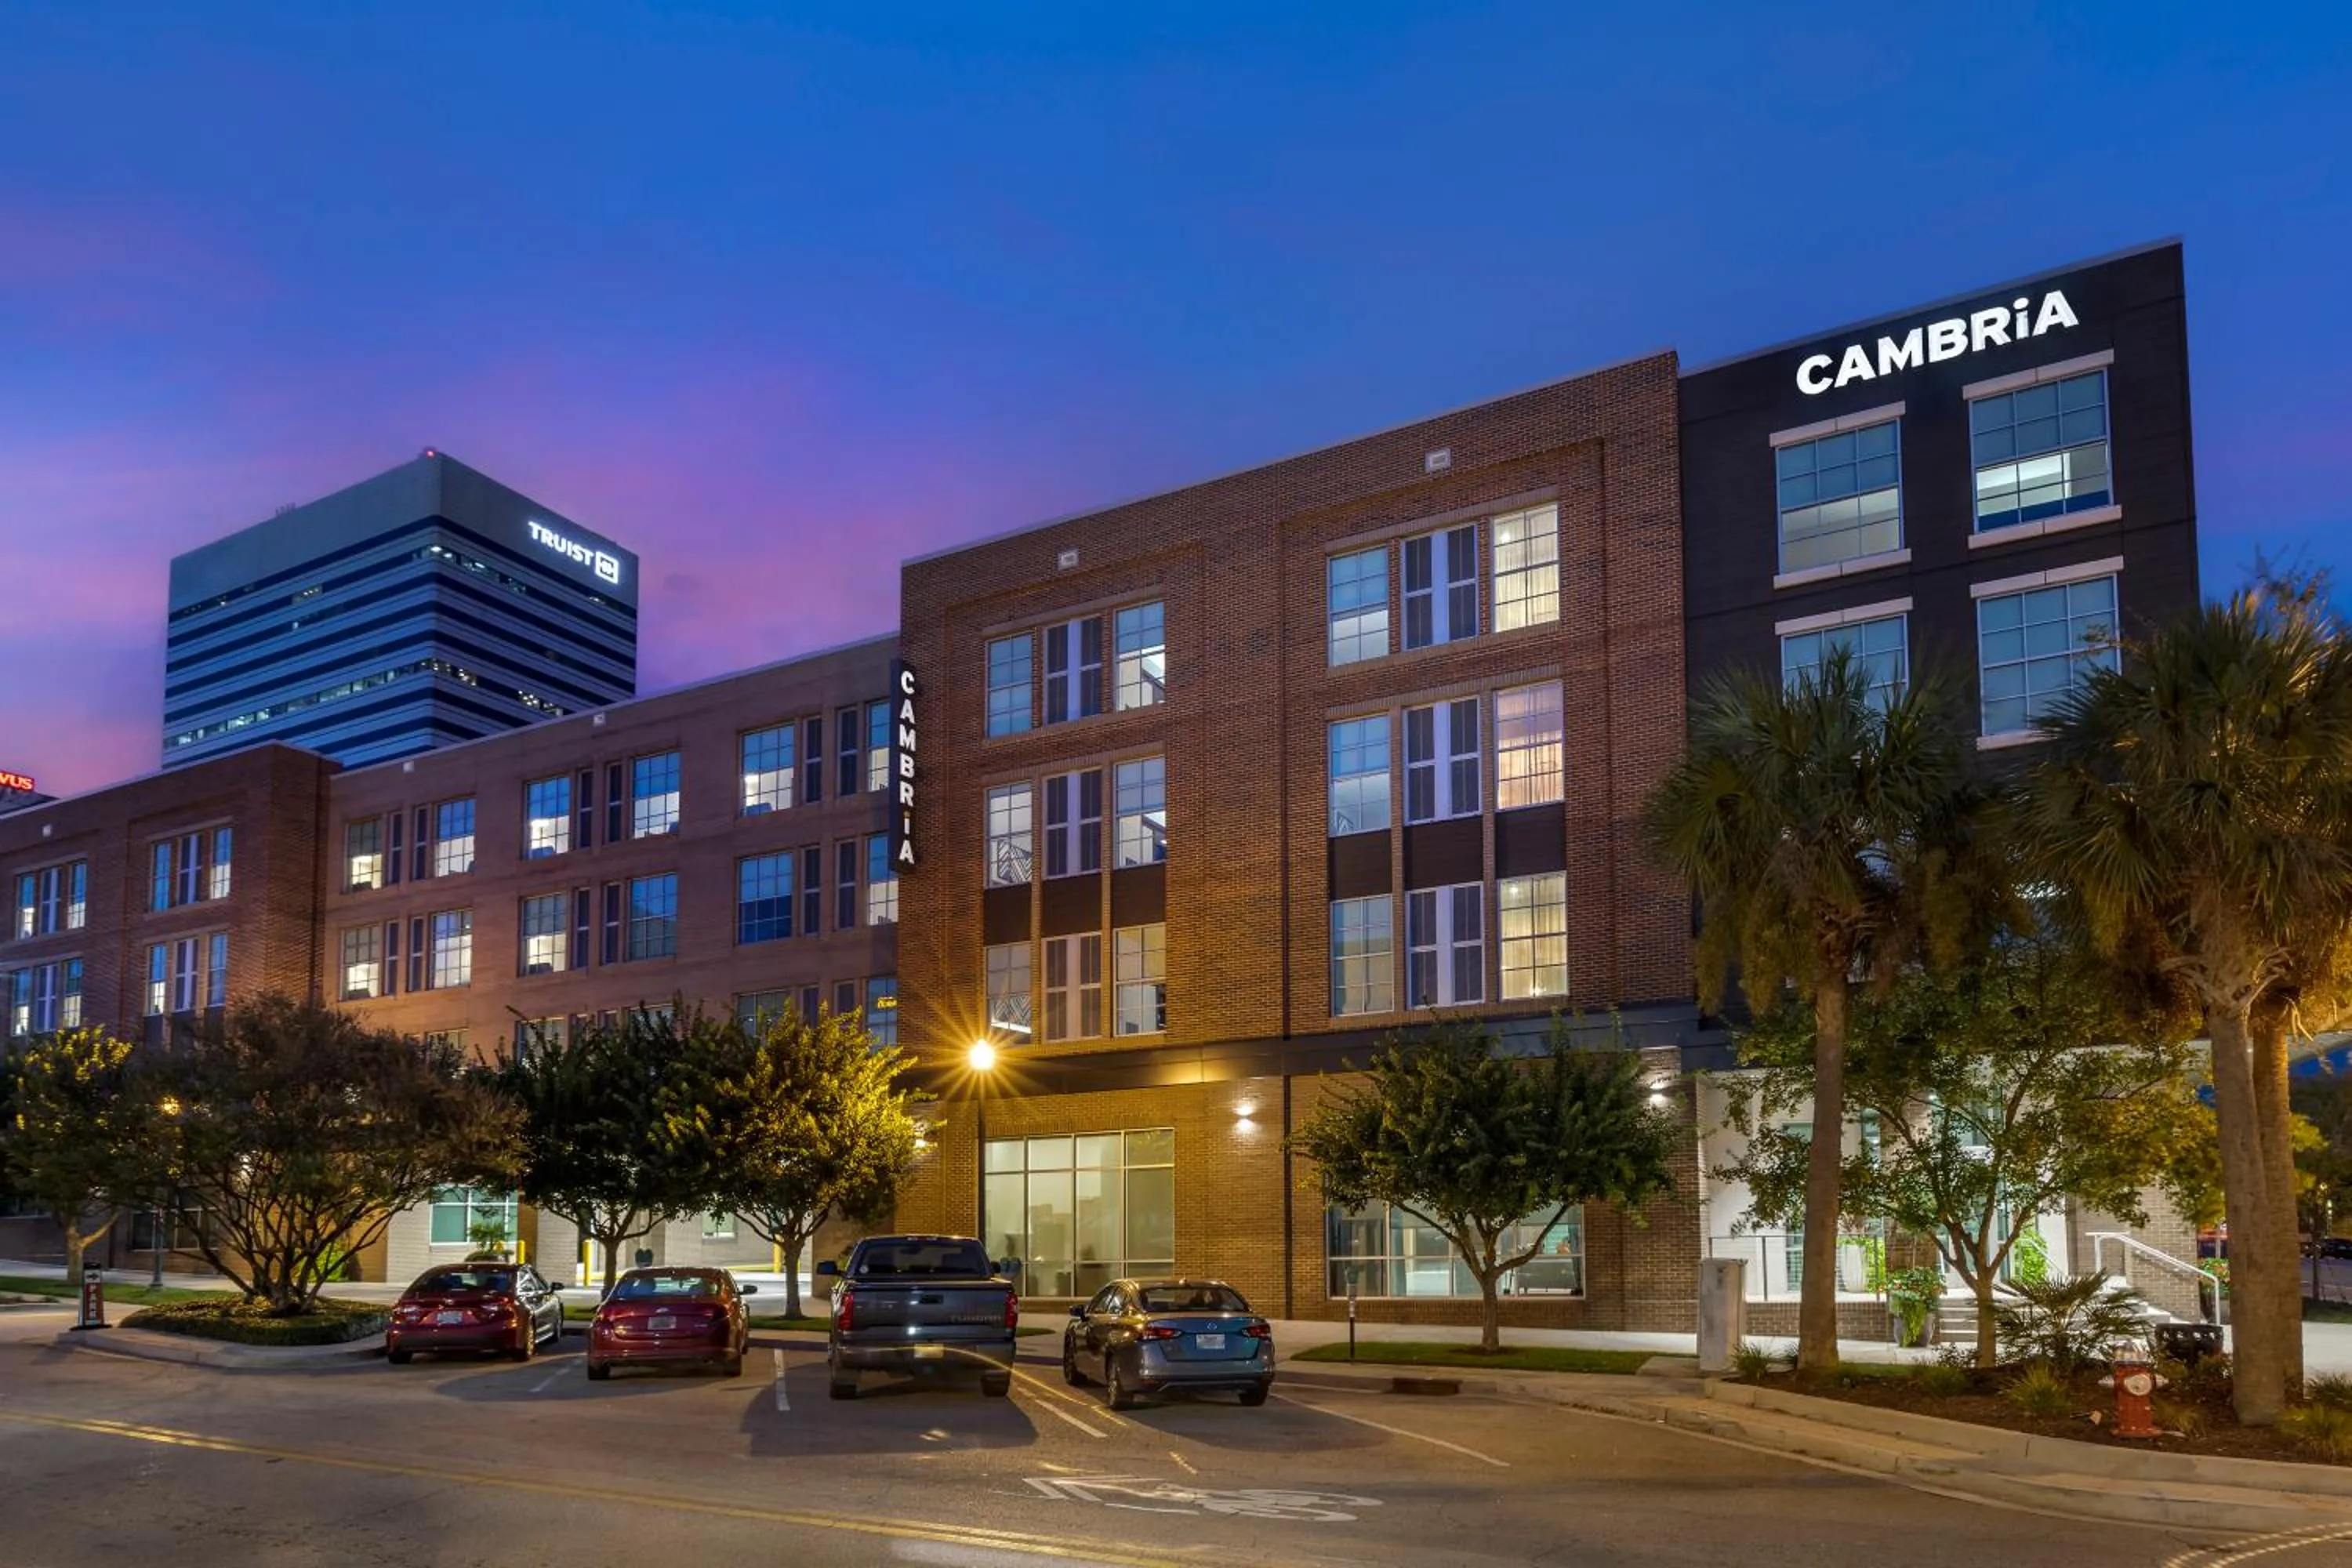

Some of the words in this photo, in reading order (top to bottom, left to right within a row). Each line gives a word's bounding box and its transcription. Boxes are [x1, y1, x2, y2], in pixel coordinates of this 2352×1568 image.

[1796, 290, 2079, 394] CAMBRiA
[528, 521, 593, 565] TRUIST
[899, 670, 916, 864] CAMBRiA
